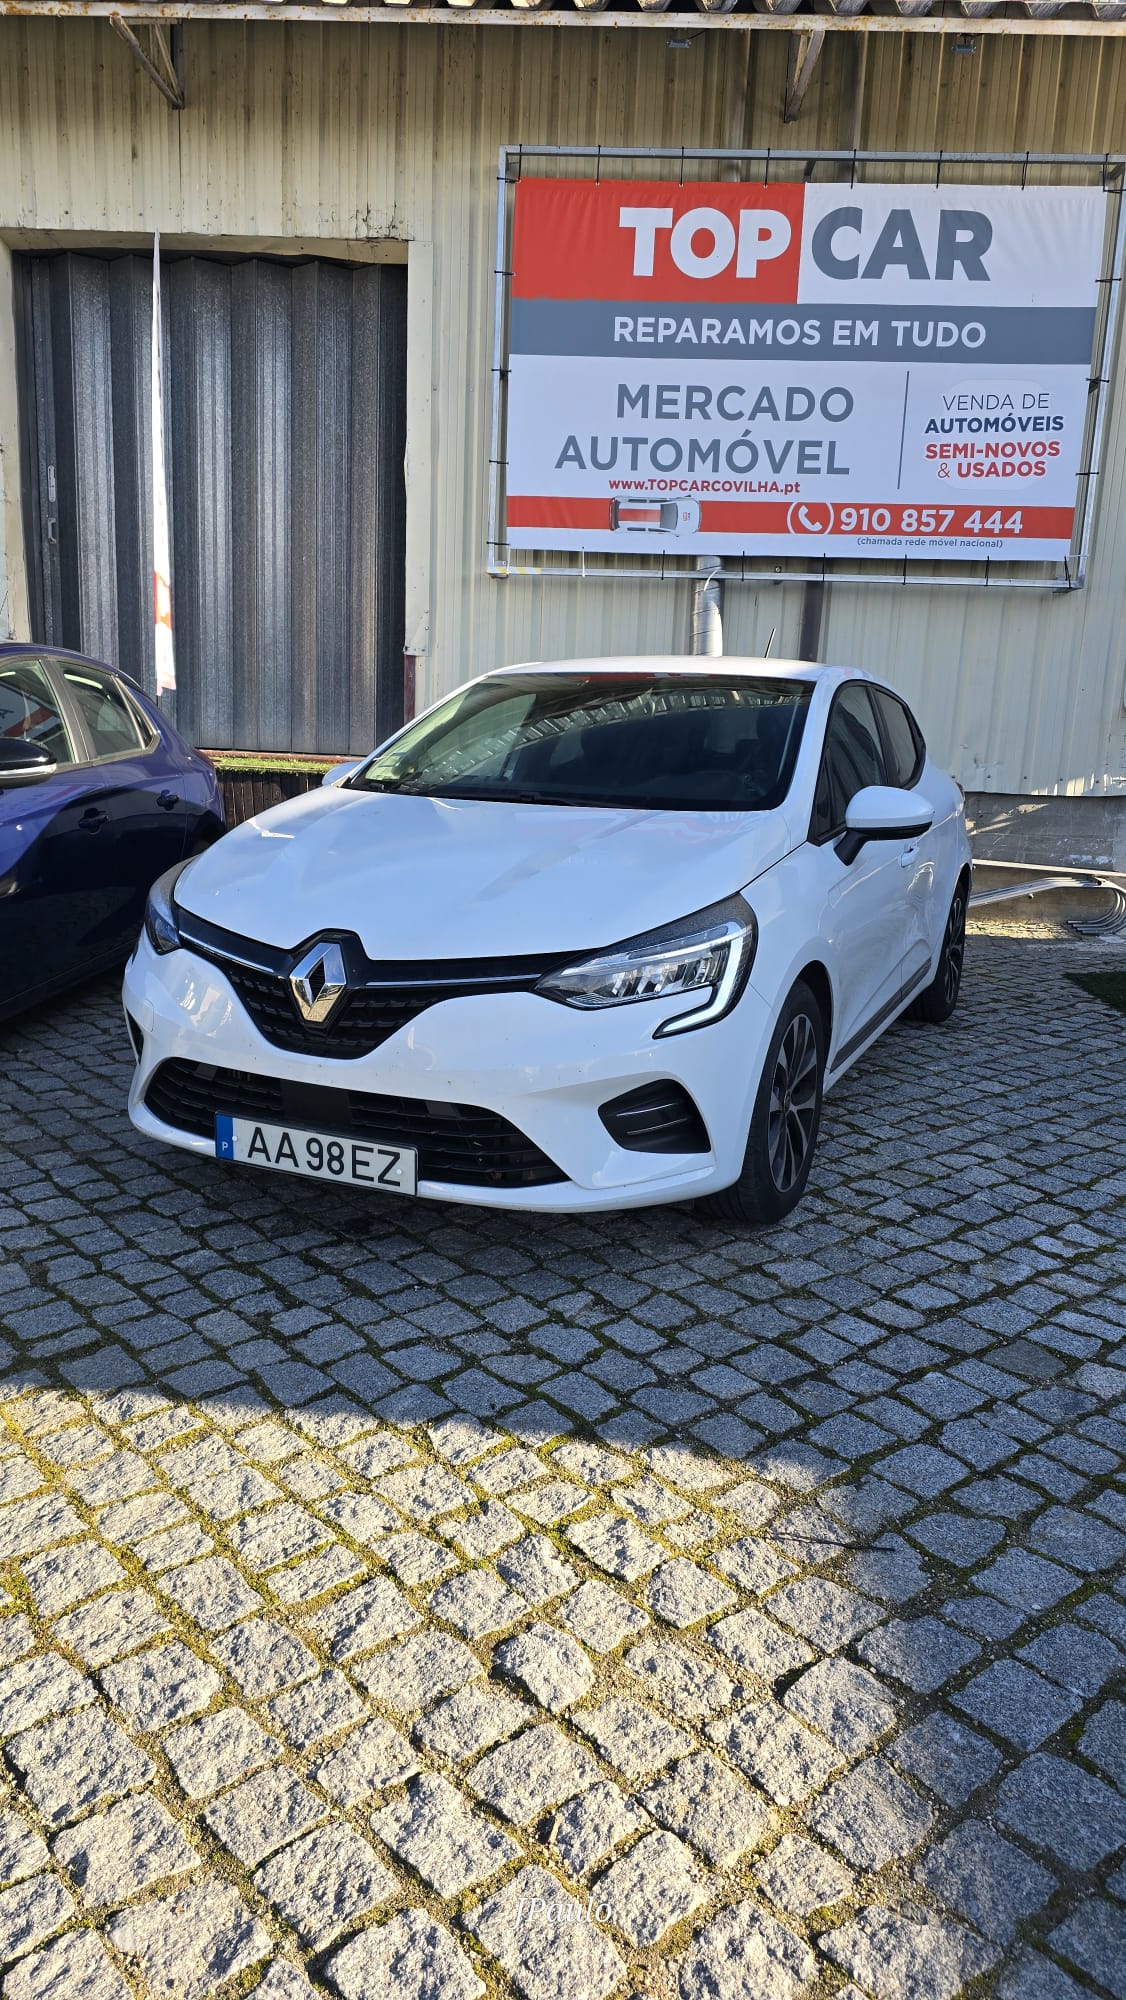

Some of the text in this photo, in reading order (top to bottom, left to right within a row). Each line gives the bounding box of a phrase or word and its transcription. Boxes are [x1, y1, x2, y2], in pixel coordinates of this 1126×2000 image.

[619, 206, 993, 281] TOP CAR
[614, 316, 987, 348] REPARAMOS EM TUDO
[617, 384, 854, 422] MERCADO
[943, 393, 1050, 411] VENDA DE
[925, 413, 1065, 434] AUTOMÓVEIS
[555, 429, 850, 475] AUTOMÓVEL
[925, 441, 1061, 459] SEMI-NOVOS
[937, 460, 1046, 478] & USADOS
[608, 478, 801, 496] www.TOPCARCOVILHA.pt
[840, 507, 1023, 534] 910 857 444
[857, 537, 1004, 549] (chamada rede móvel nacional)
[221, 1141, 229, 1151] P
